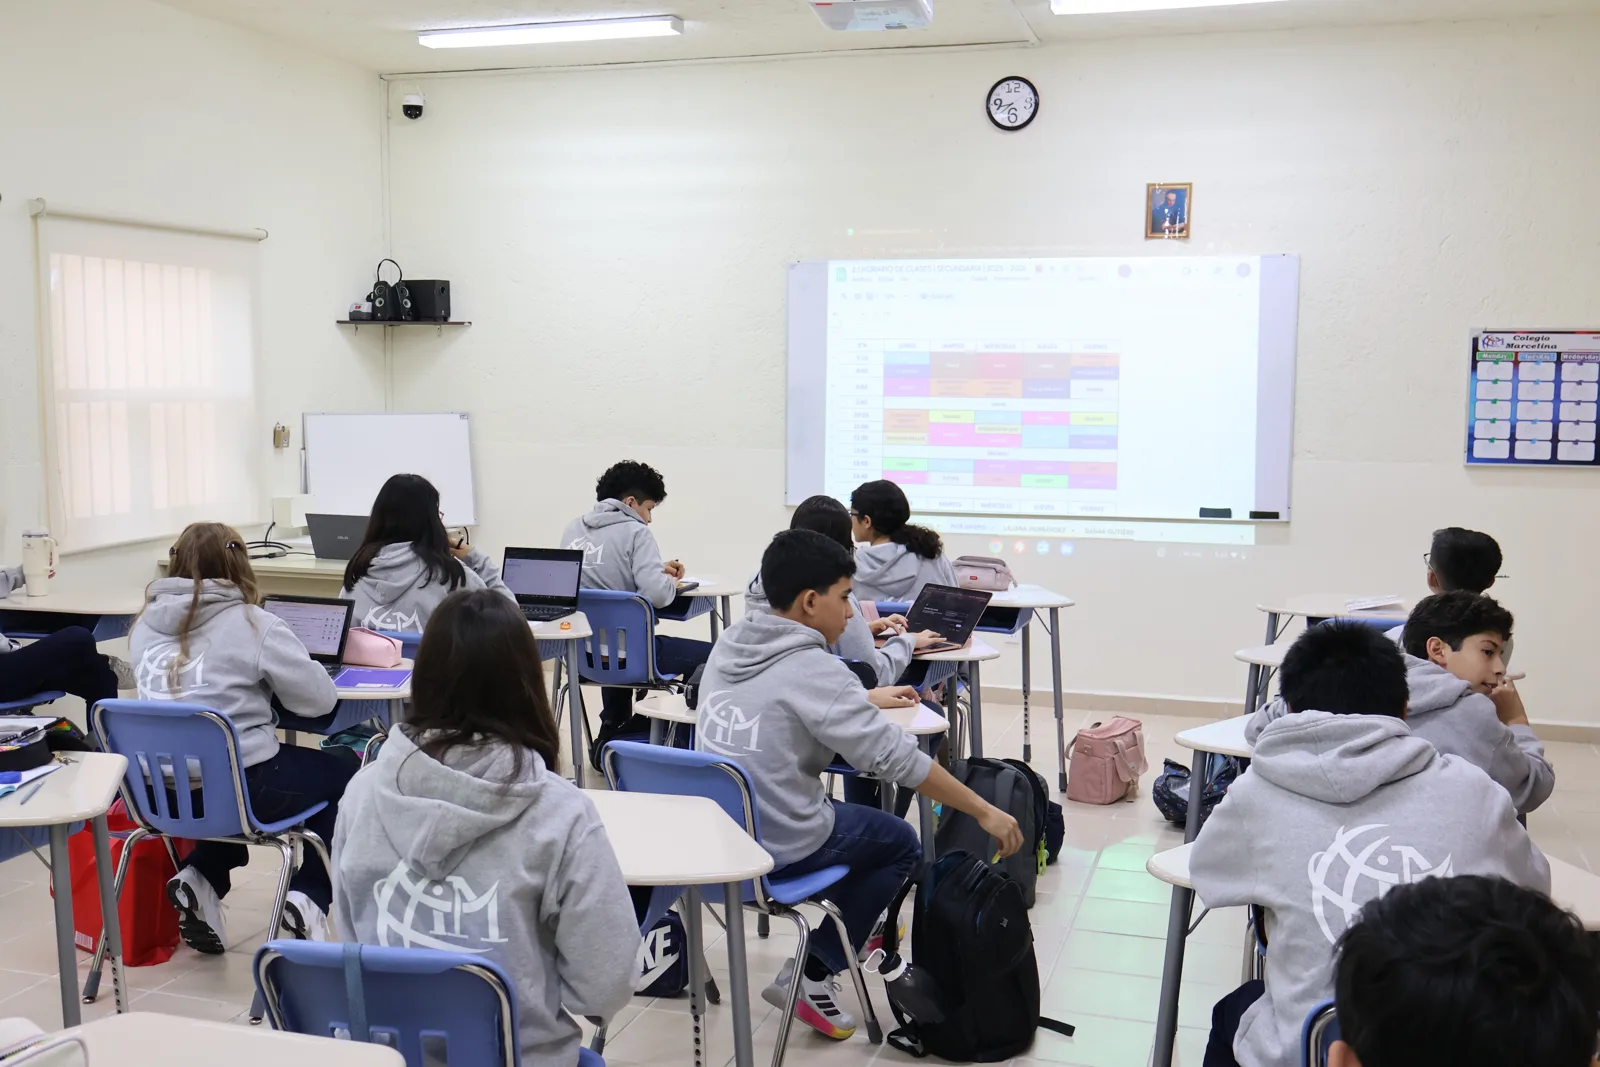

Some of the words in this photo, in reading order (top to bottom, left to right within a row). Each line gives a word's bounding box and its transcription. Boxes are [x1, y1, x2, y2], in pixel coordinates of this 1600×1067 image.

[1005, 82, 1021, 93] 12
[993, 98, 1003, 111] 9
[1023, 97, 1033, 110] 3
[1007, 107, 1018, 124] 6
[1512, 335, 1551, 343] Colegio
[1482, 352, 1508, 360] Monday
[1524, 353, 1551, 361] Tuesday
[1562, 353, 1599, 361] Wednesday
[636, 924, 672, 974] KE
